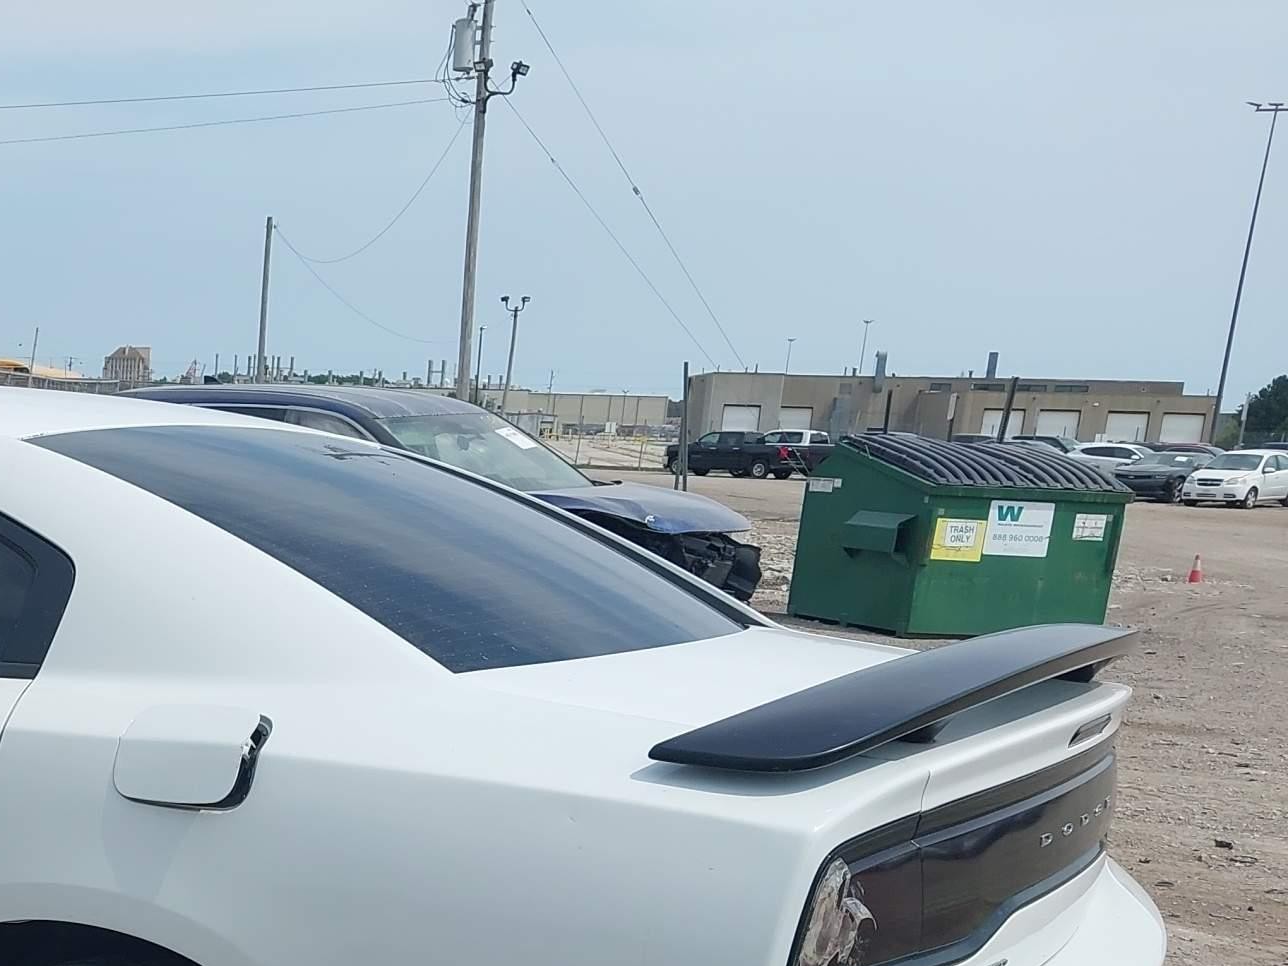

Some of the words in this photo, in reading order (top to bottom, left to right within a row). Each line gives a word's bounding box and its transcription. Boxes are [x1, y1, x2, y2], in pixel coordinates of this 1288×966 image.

[949, 525, 975, 534] TRASH
[949, 534, 971, 543] ONLY
[1008, 534, 1023, 542] 960
